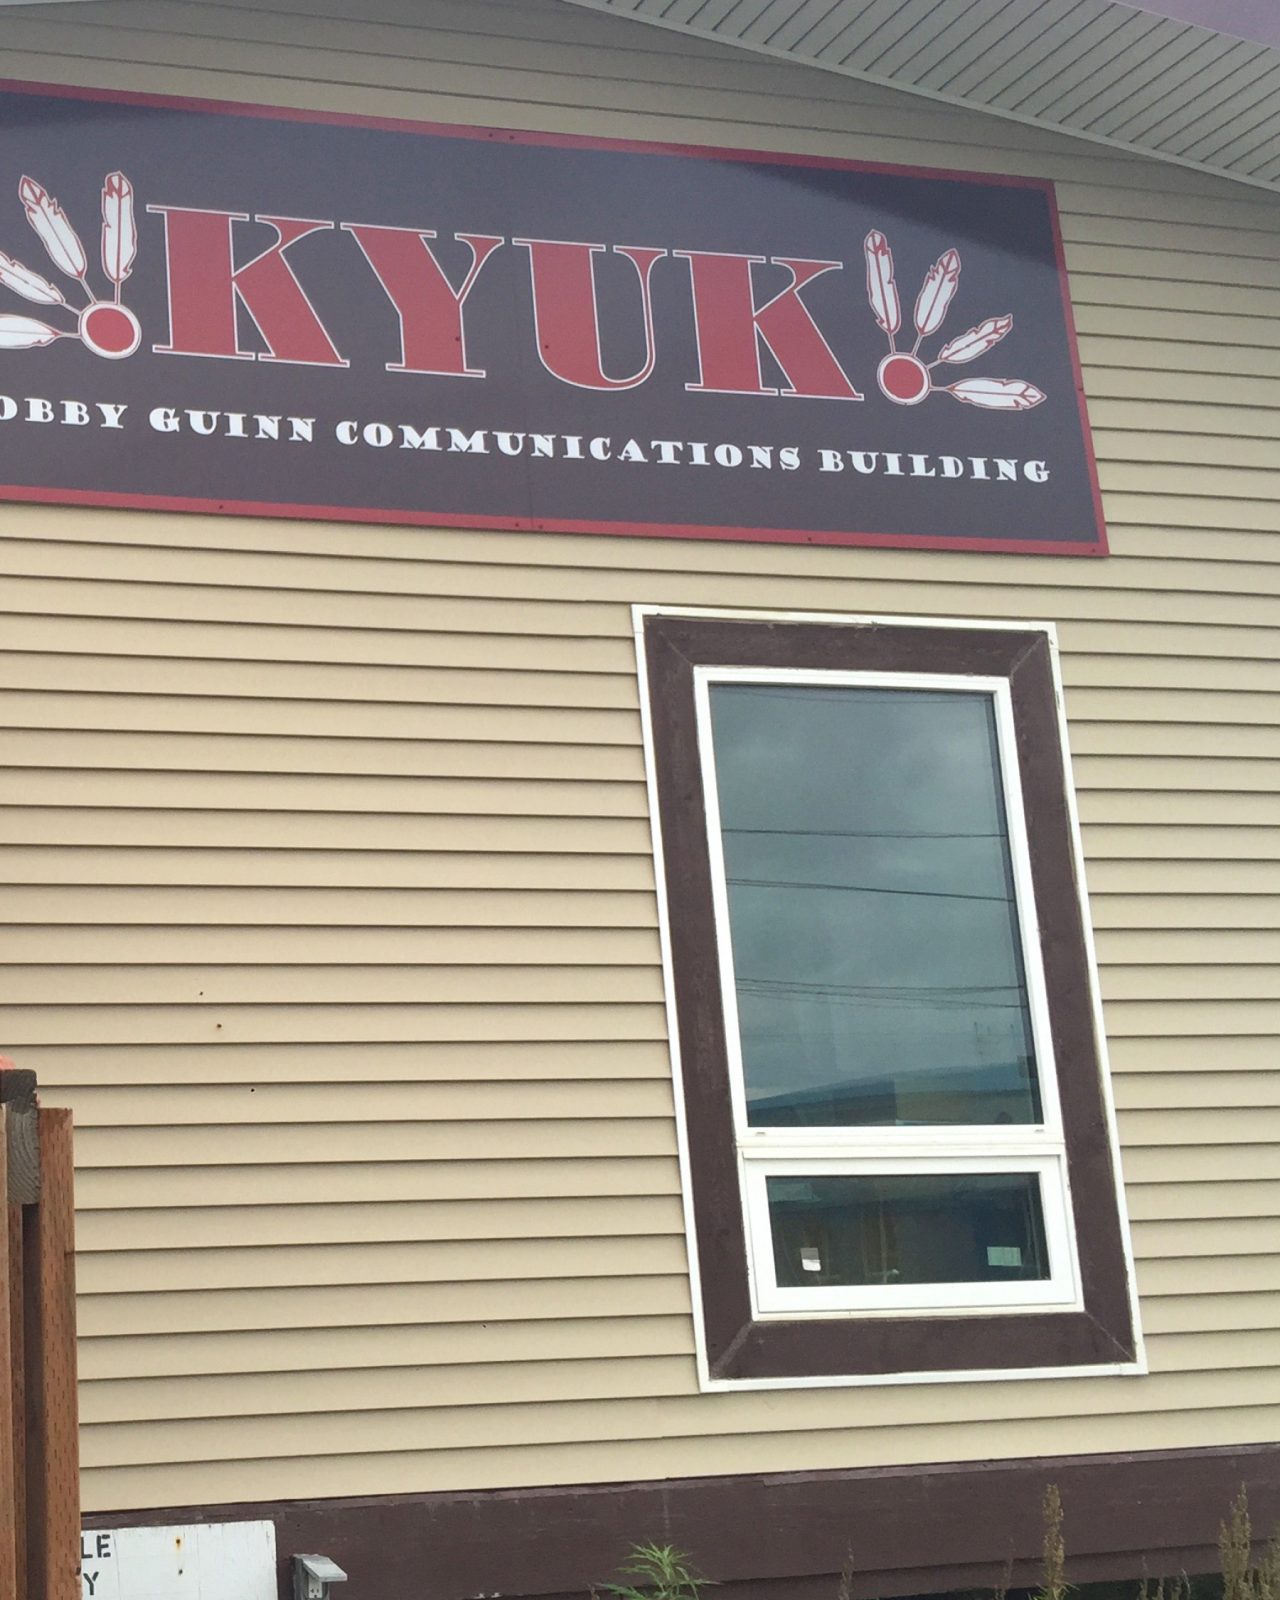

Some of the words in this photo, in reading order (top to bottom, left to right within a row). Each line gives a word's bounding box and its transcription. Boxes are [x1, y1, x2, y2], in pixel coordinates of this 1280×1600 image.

[146, 204, 865, 402] KYUK
[150, 407, 316, 443] GUINN
[335, 420, 801, 471] COMMUNICATIONS
[818, 449, 1050, 484] BUILDING
[80, 1534, 111, 1559] LE
